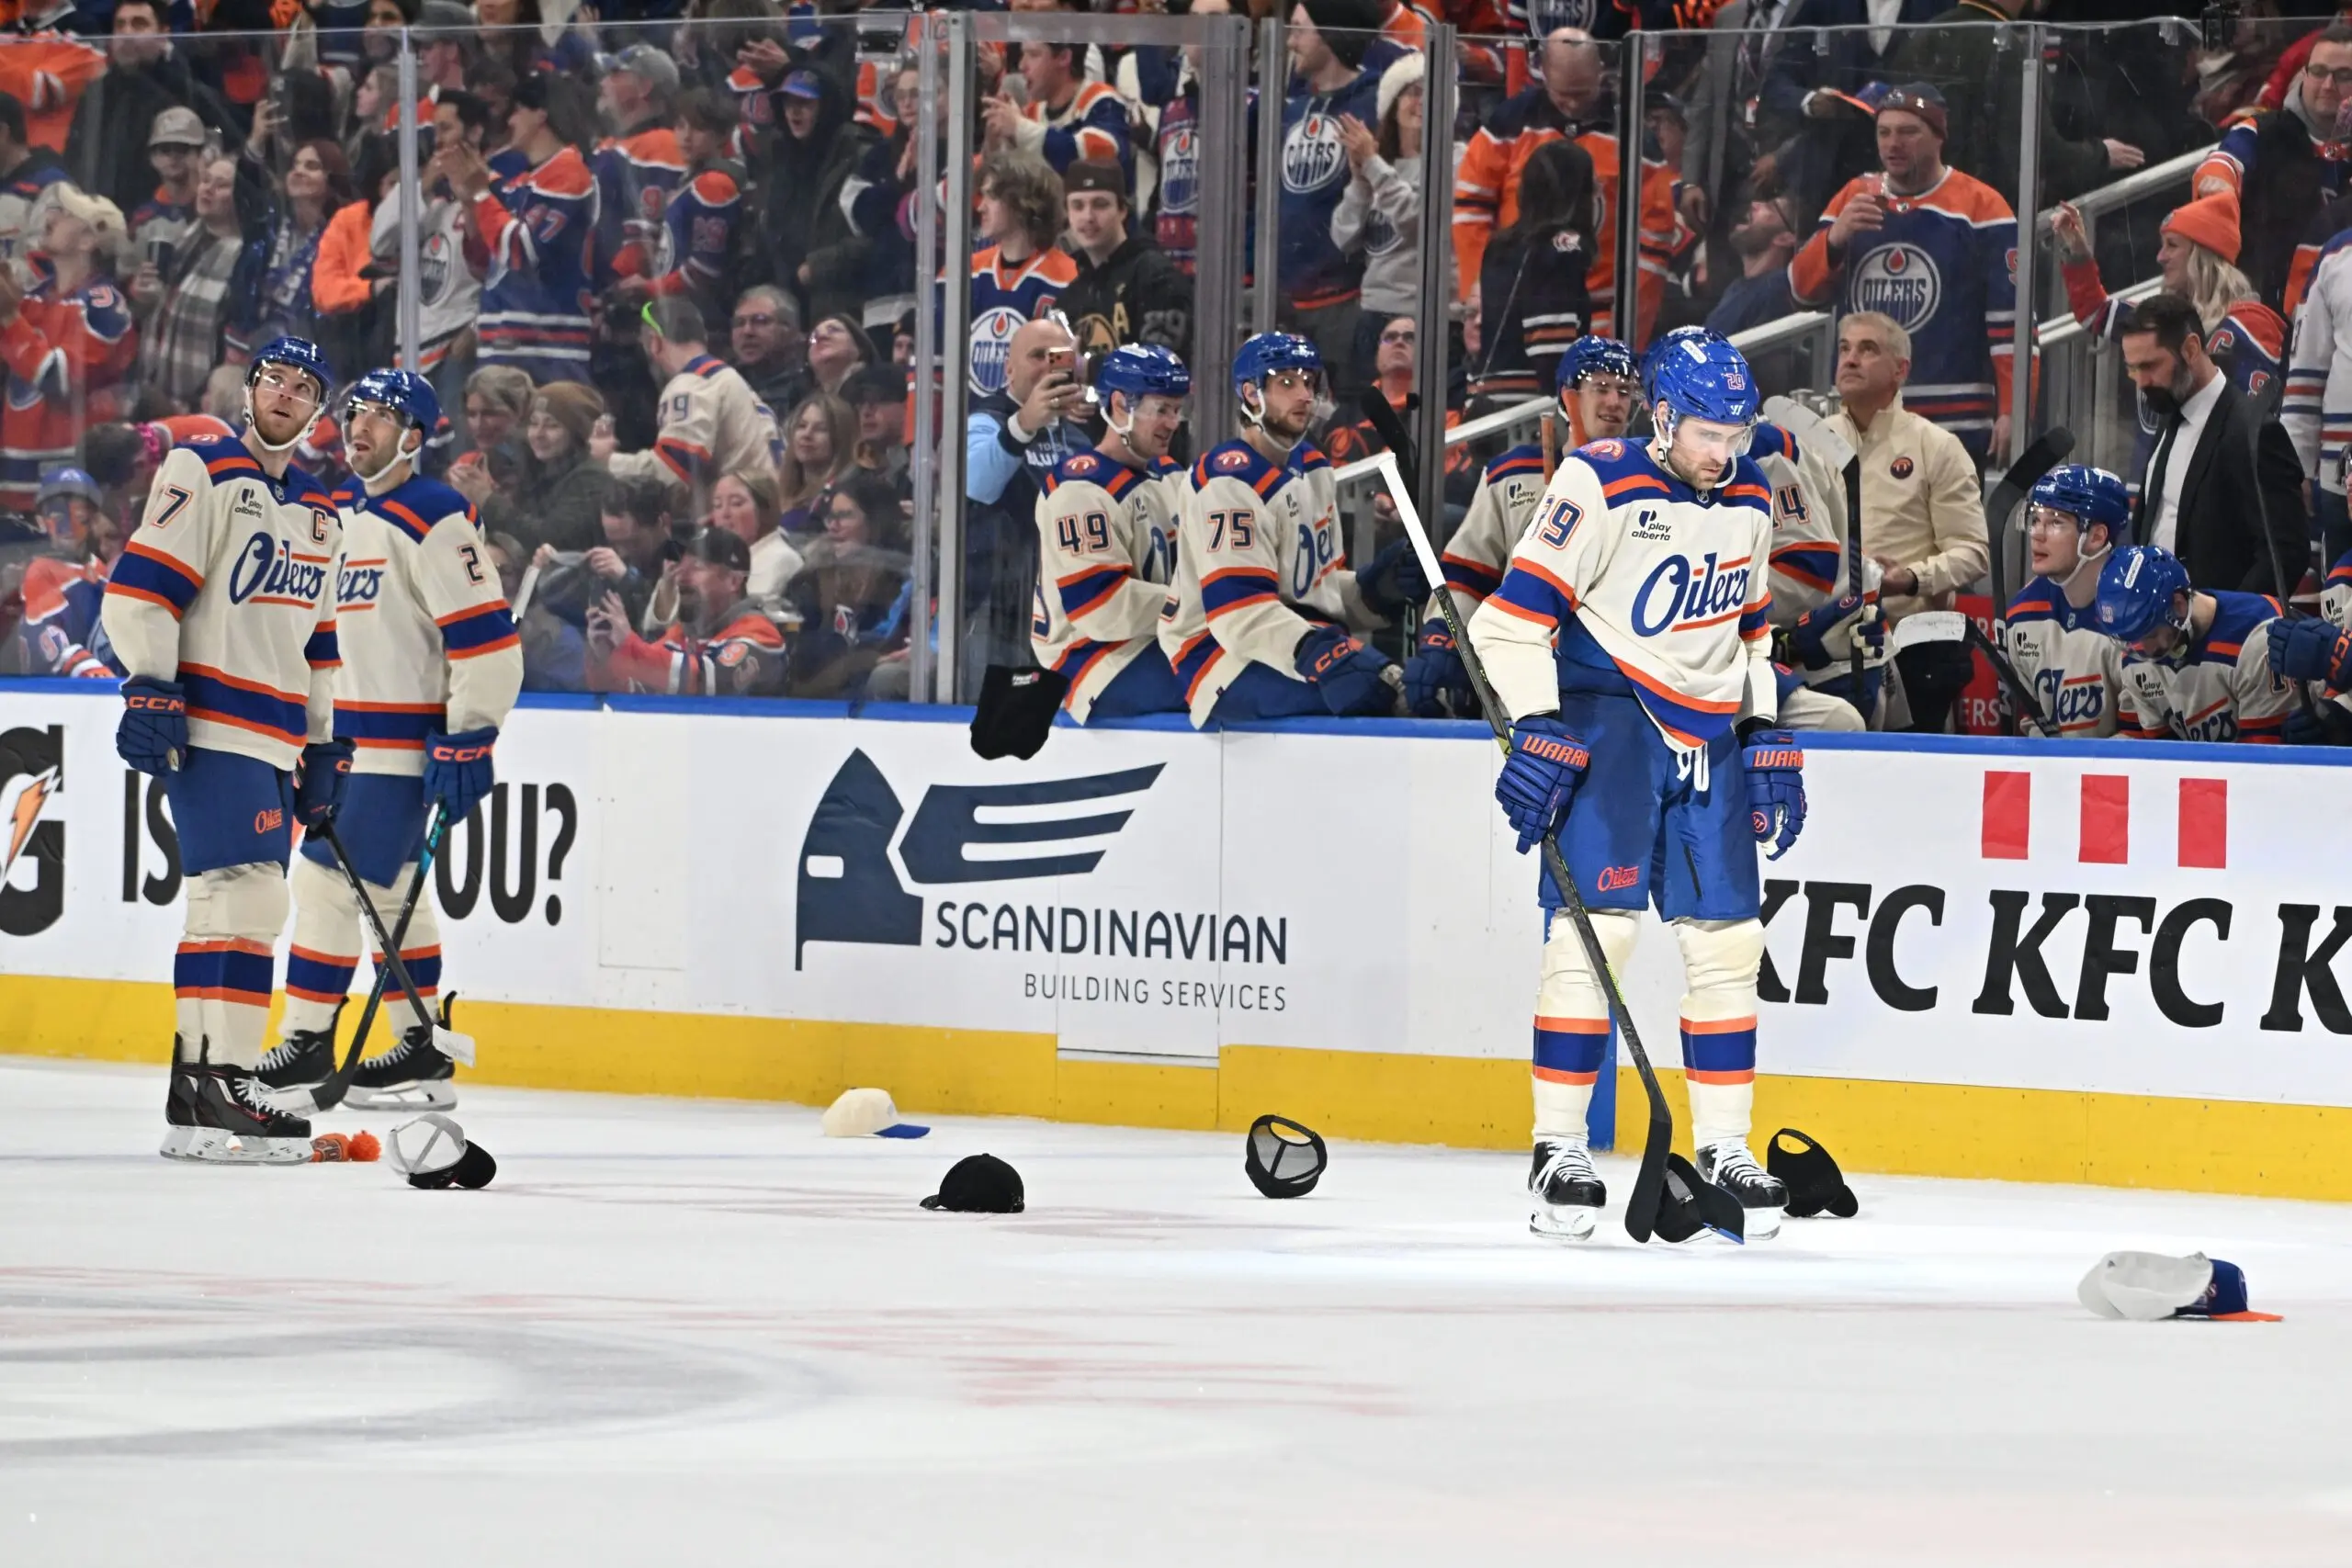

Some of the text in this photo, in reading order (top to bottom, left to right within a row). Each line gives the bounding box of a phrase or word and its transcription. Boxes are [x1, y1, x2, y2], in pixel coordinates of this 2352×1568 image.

[1862, 278, 1927, 301] OILERS
[1725, 373, 1745, 390] 29
[151, 483, 192, 529] 7
[1516, 490, 1535, 501] play
[311, 506, 328, 545] C
[1057, 511, 1113, 554] 49
[1207, 509, 1254, 552] 75
[1534, 496, 1584, 550] 9
[1632, 530, 1671, 541] alberta
[1648, 522, 1671, 534] play
[230, 531, 326, 605] Oilers
[336, 552, 385, 603] lers
[458, 543, 485, 586] 2
[1630, 552, 1750, 637] Oilers
[2024, 641, 2039, 650] play
[129, 696, 186, 712] CCM
[2035, 668, 2104, 722] Olers
[254, 808, 282, 834] Oilers
[123, 769, 183, 906] IS
[434, 783, 578, 929] OU?
[1597, 865, 1639, 892] Oilers
[936, 900, 1287, 964] SCANDINAVIAN
[1972, 889, 2233, 1029] KFC
[1023, 973, 1286, 1011] BUILDING SERVICES
